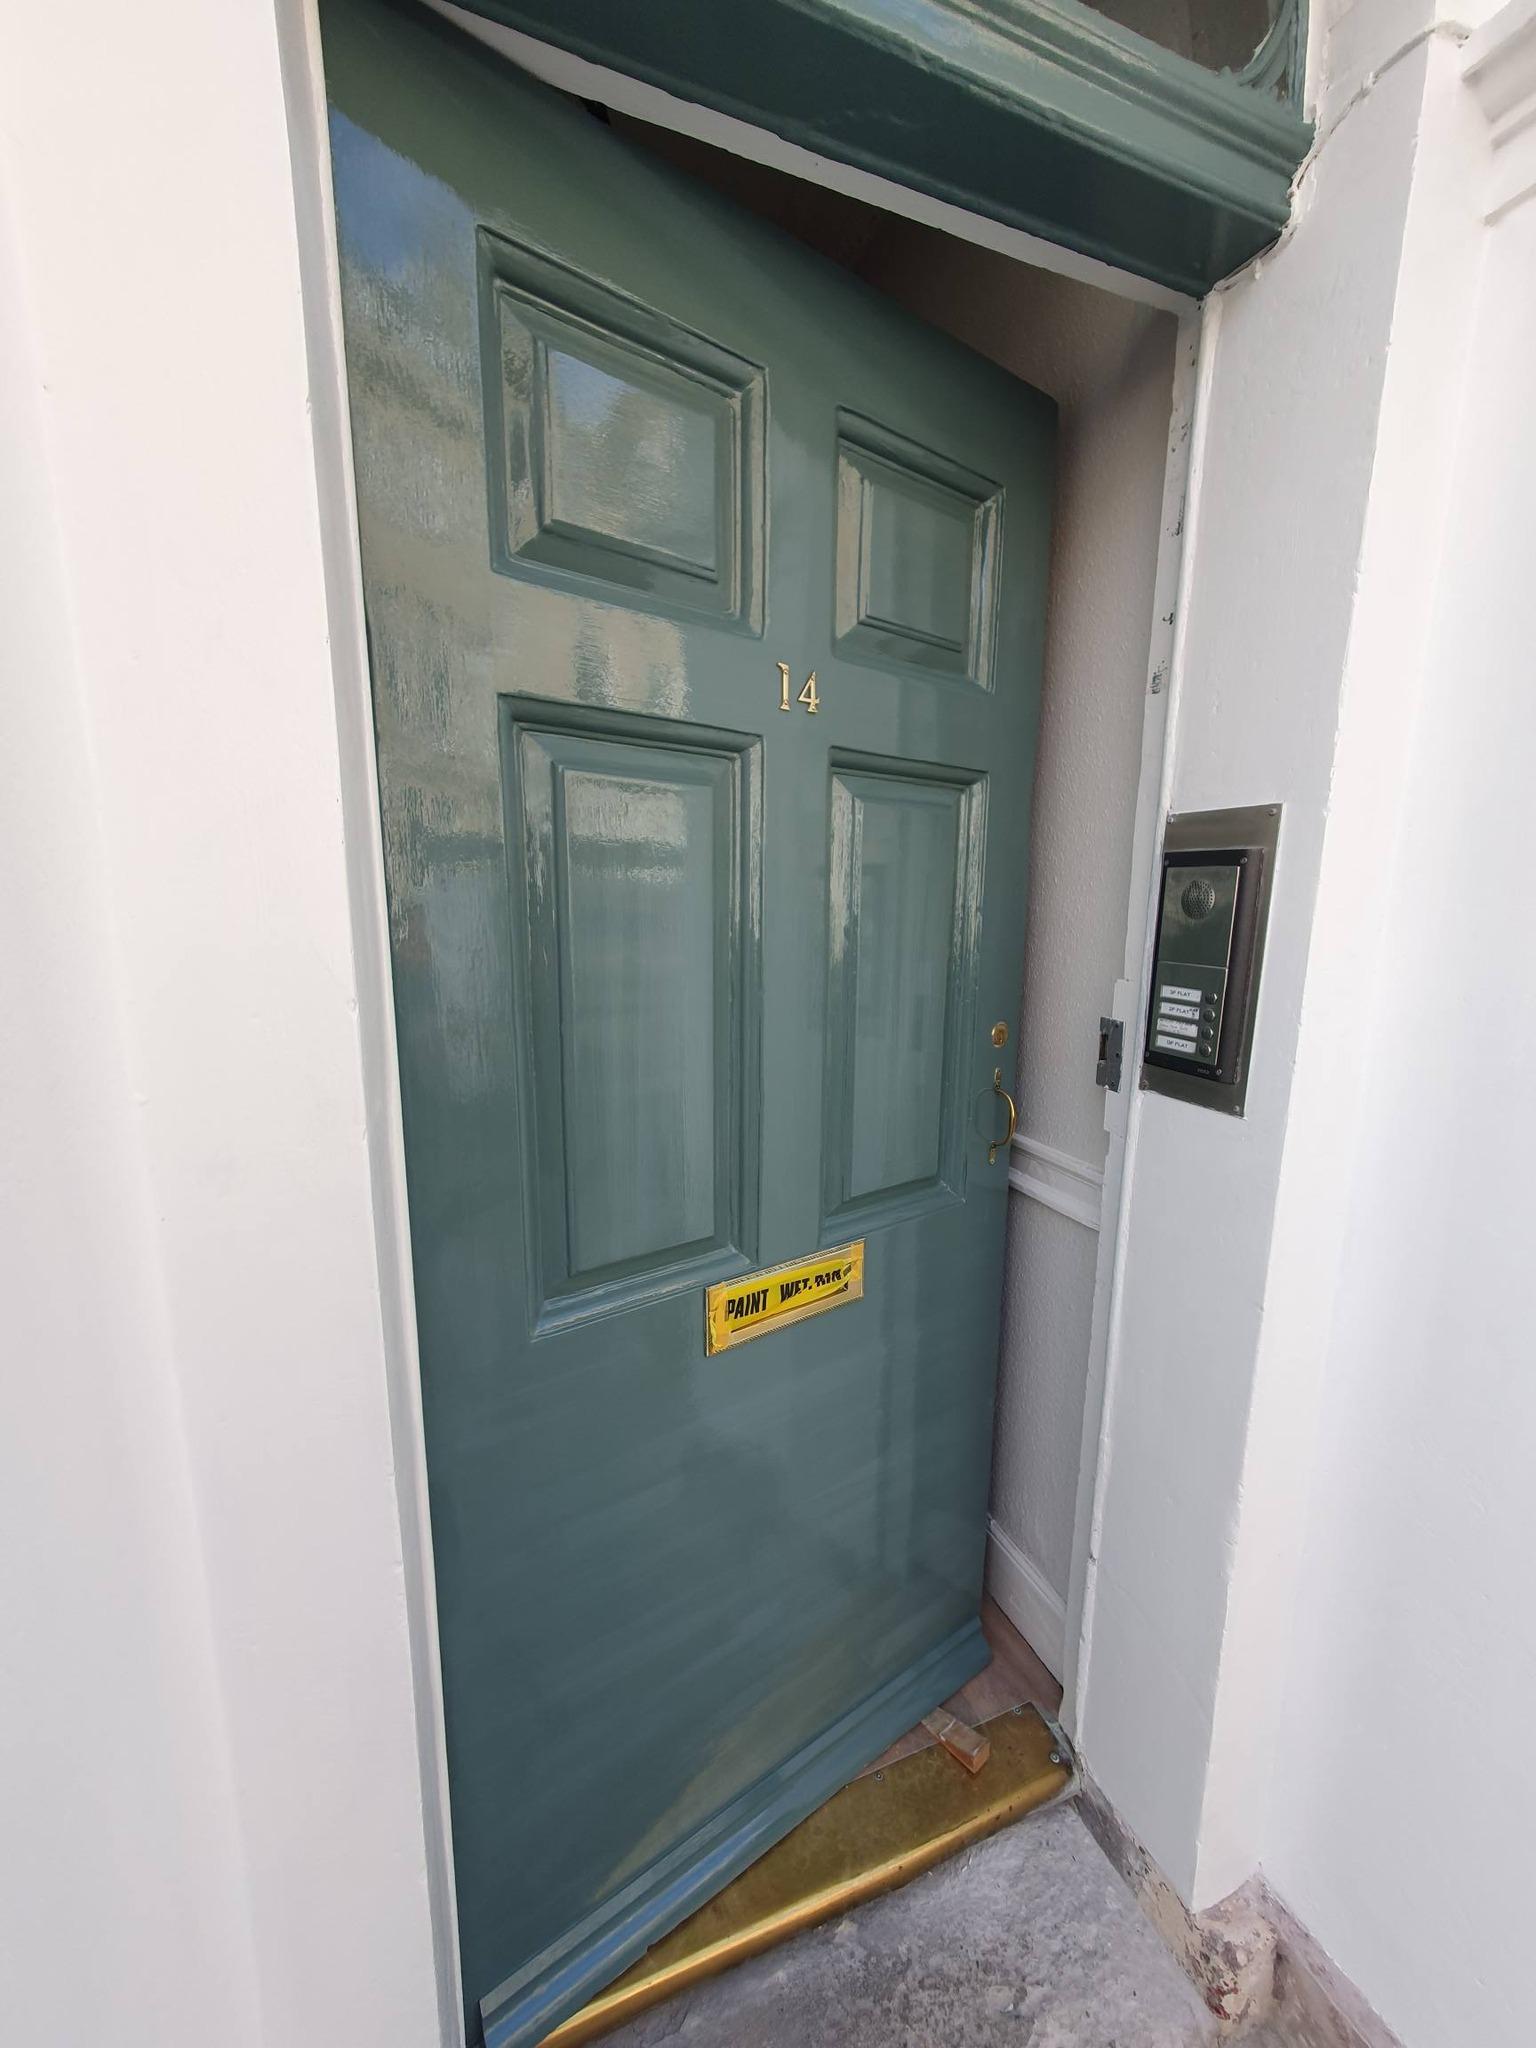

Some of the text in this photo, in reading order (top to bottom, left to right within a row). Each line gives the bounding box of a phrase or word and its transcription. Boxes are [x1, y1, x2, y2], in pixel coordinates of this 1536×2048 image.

[776, 661, 820, 713] 14
[1174, 1041, 1188, 1049] FLAT
[724, 1289, 769, 1321] PAINT
